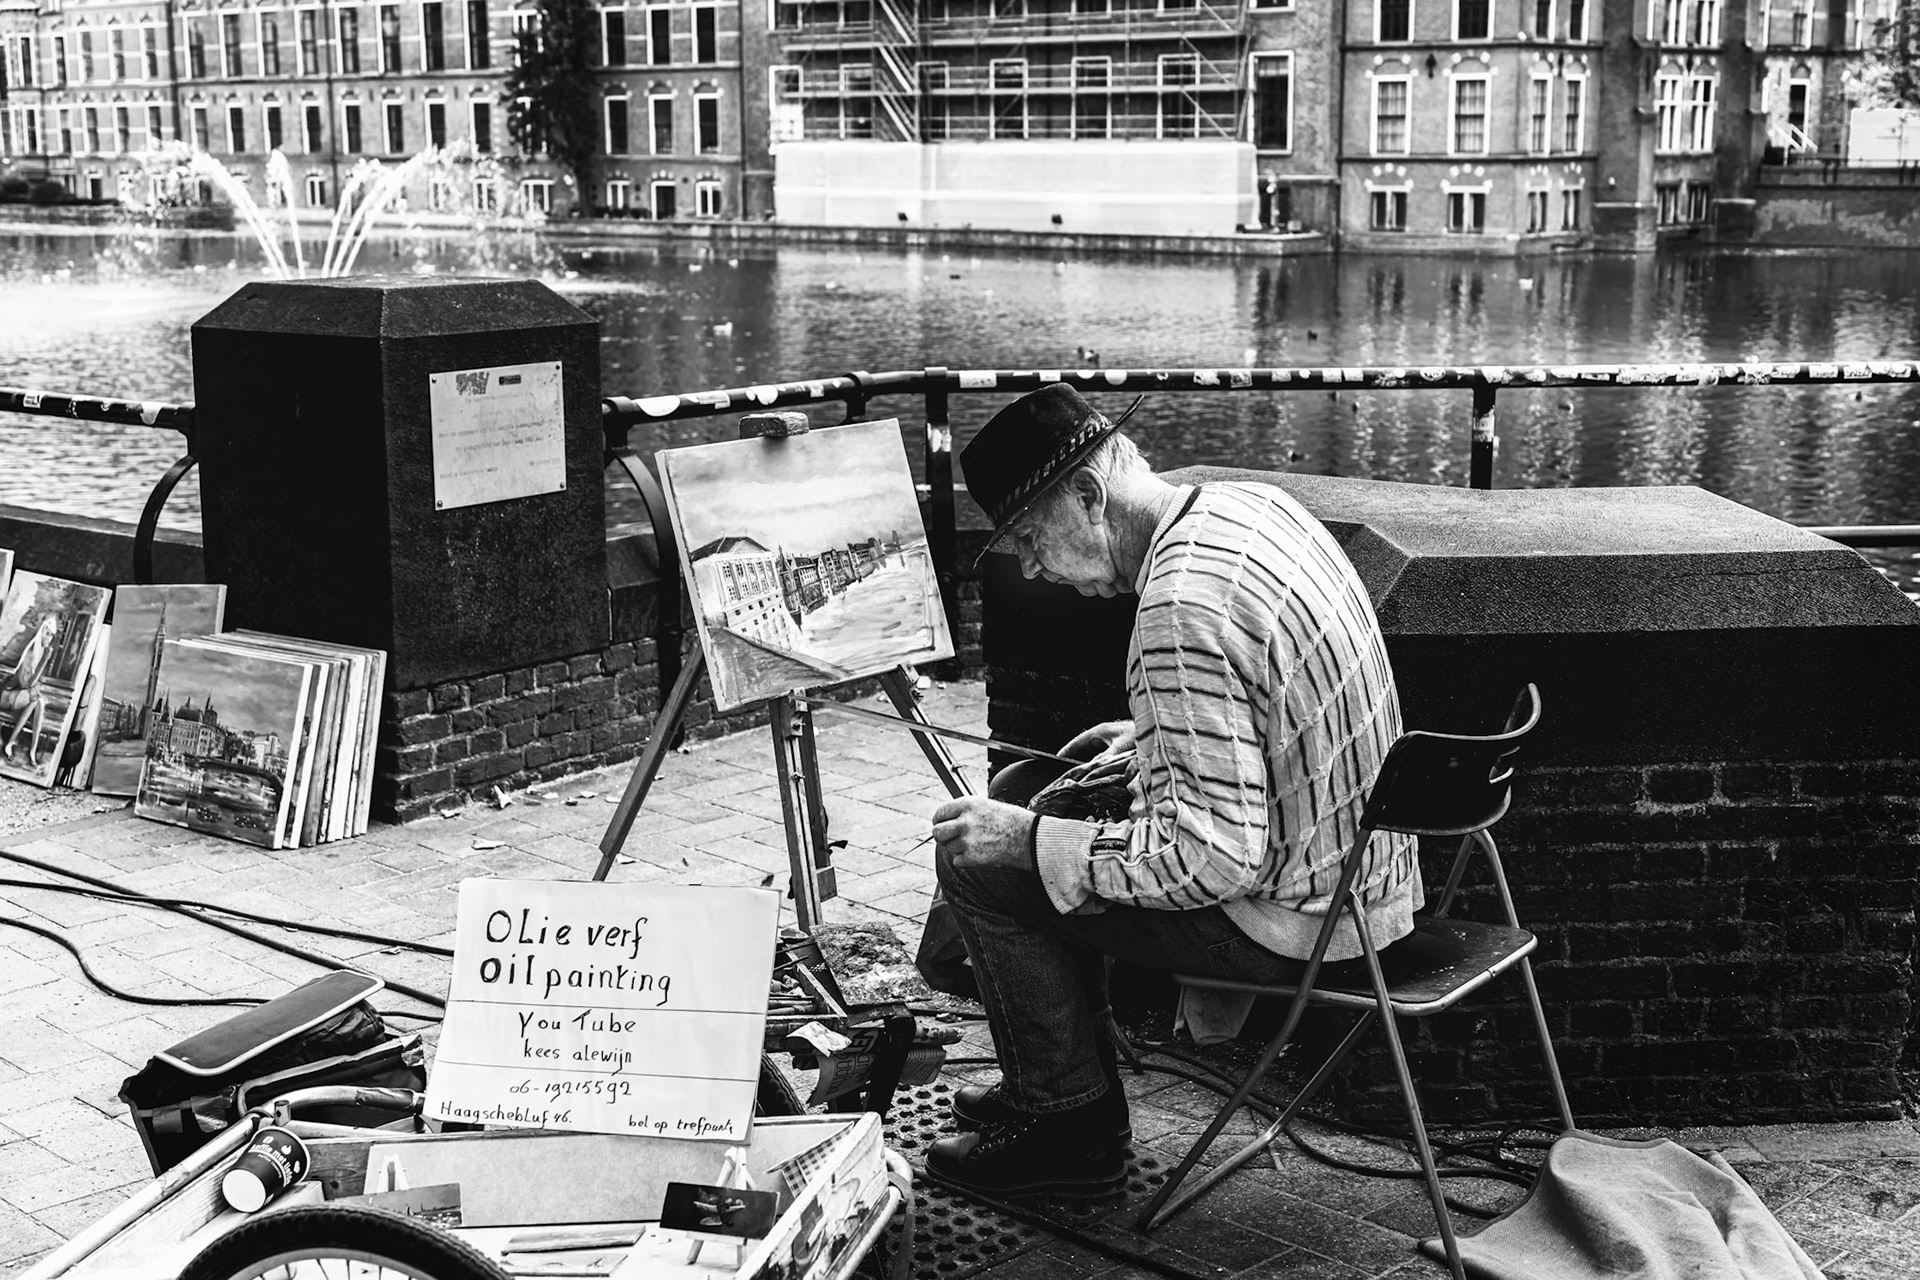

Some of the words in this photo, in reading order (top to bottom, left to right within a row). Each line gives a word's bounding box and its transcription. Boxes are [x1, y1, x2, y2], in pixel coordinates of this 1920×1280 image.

[587, 917, 649, 960] verf
[542, 965, 671, 1007] painting
[518, 1011, 561, 1038] You
[571, 1008, 636, 1033] Tube
[523, 1039, 560, 1060] kees
[572, 1045, 632, 1077] alewijn
[509, 1080, 632, 1104] 06-19215592
[654, 1121, 668, 1134] op
